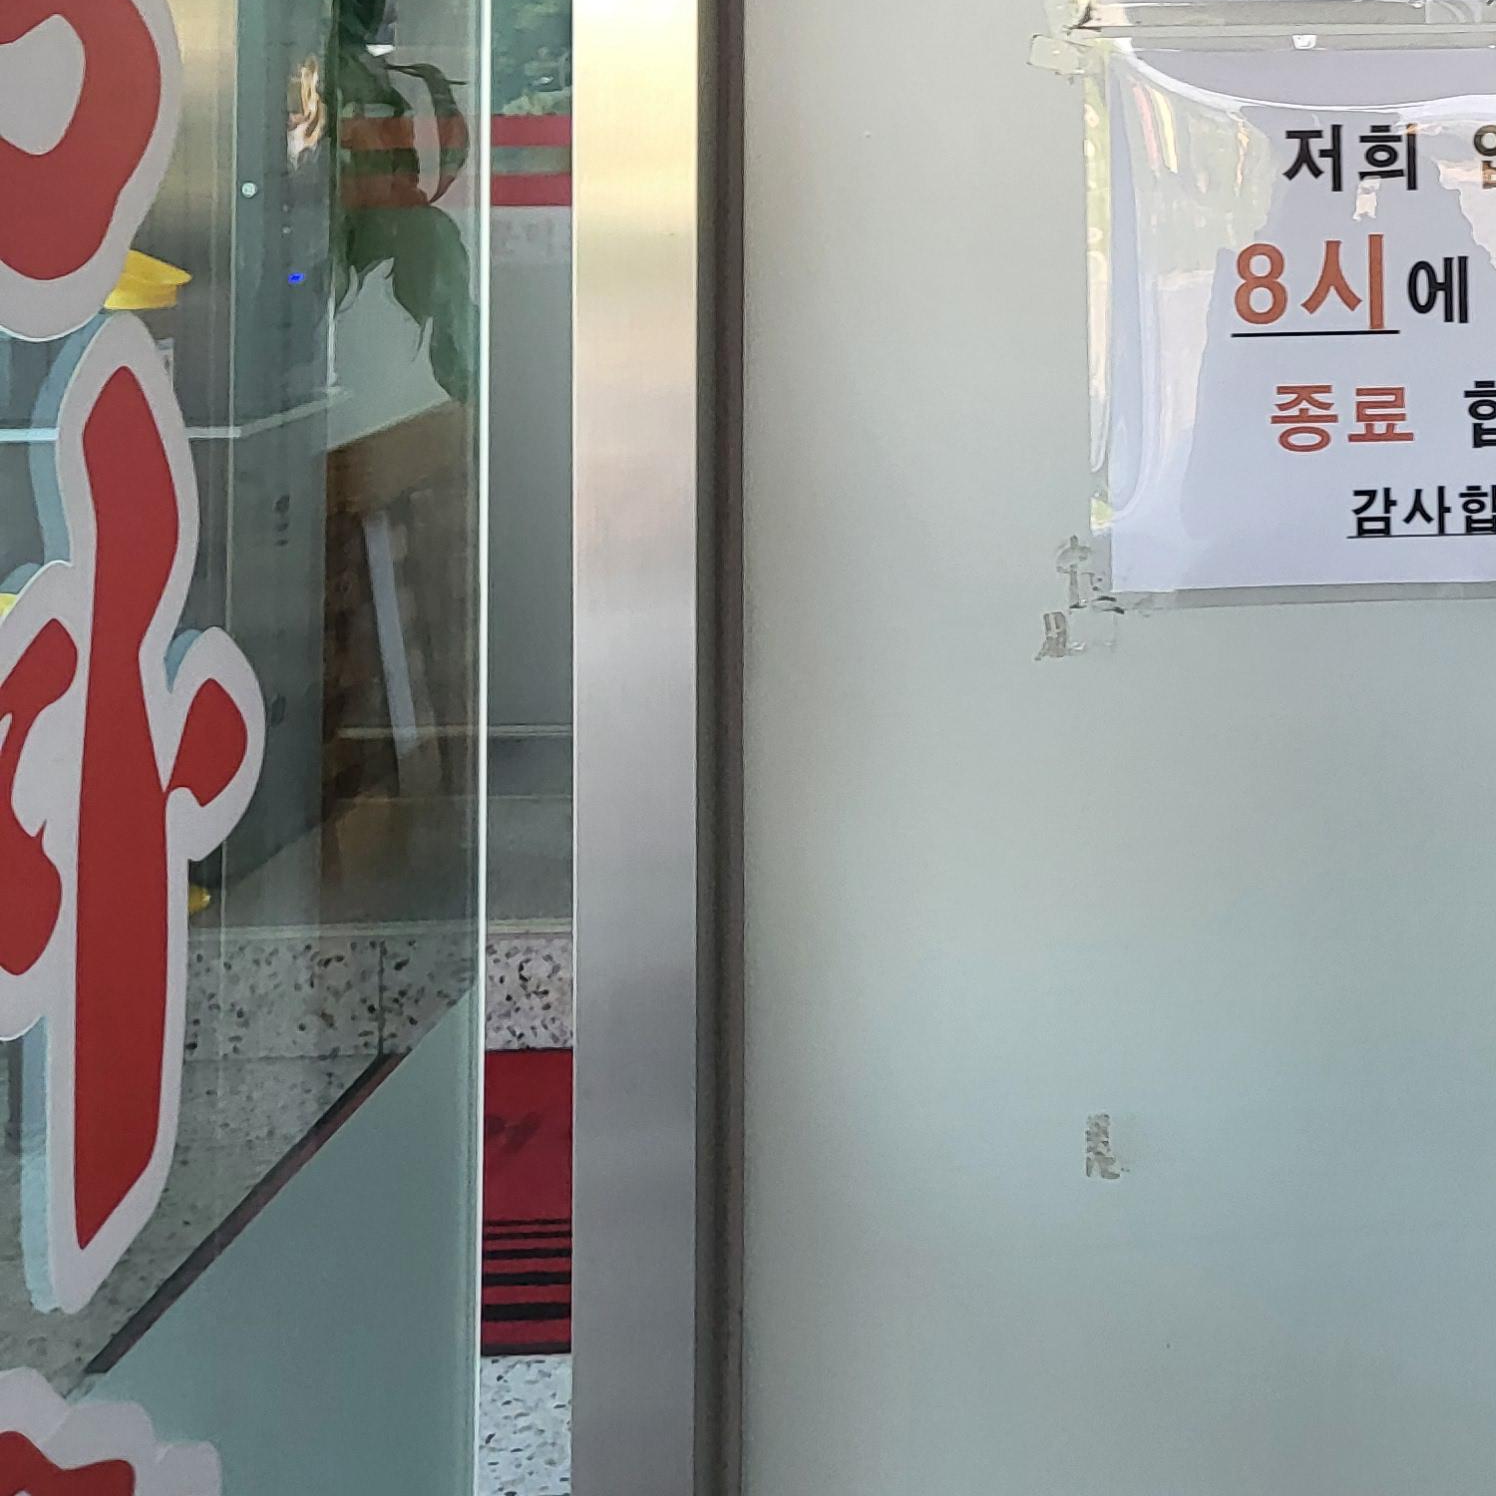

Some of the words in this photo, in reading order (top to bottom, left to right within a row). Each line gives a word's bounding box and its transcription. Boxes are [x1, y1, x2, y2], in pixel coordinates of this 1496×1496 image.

[1282, 121, 1419, 193] 저희
[1231, 232, 1471, 332] 8시에
[1268, 382, 1417, 454] 종료
